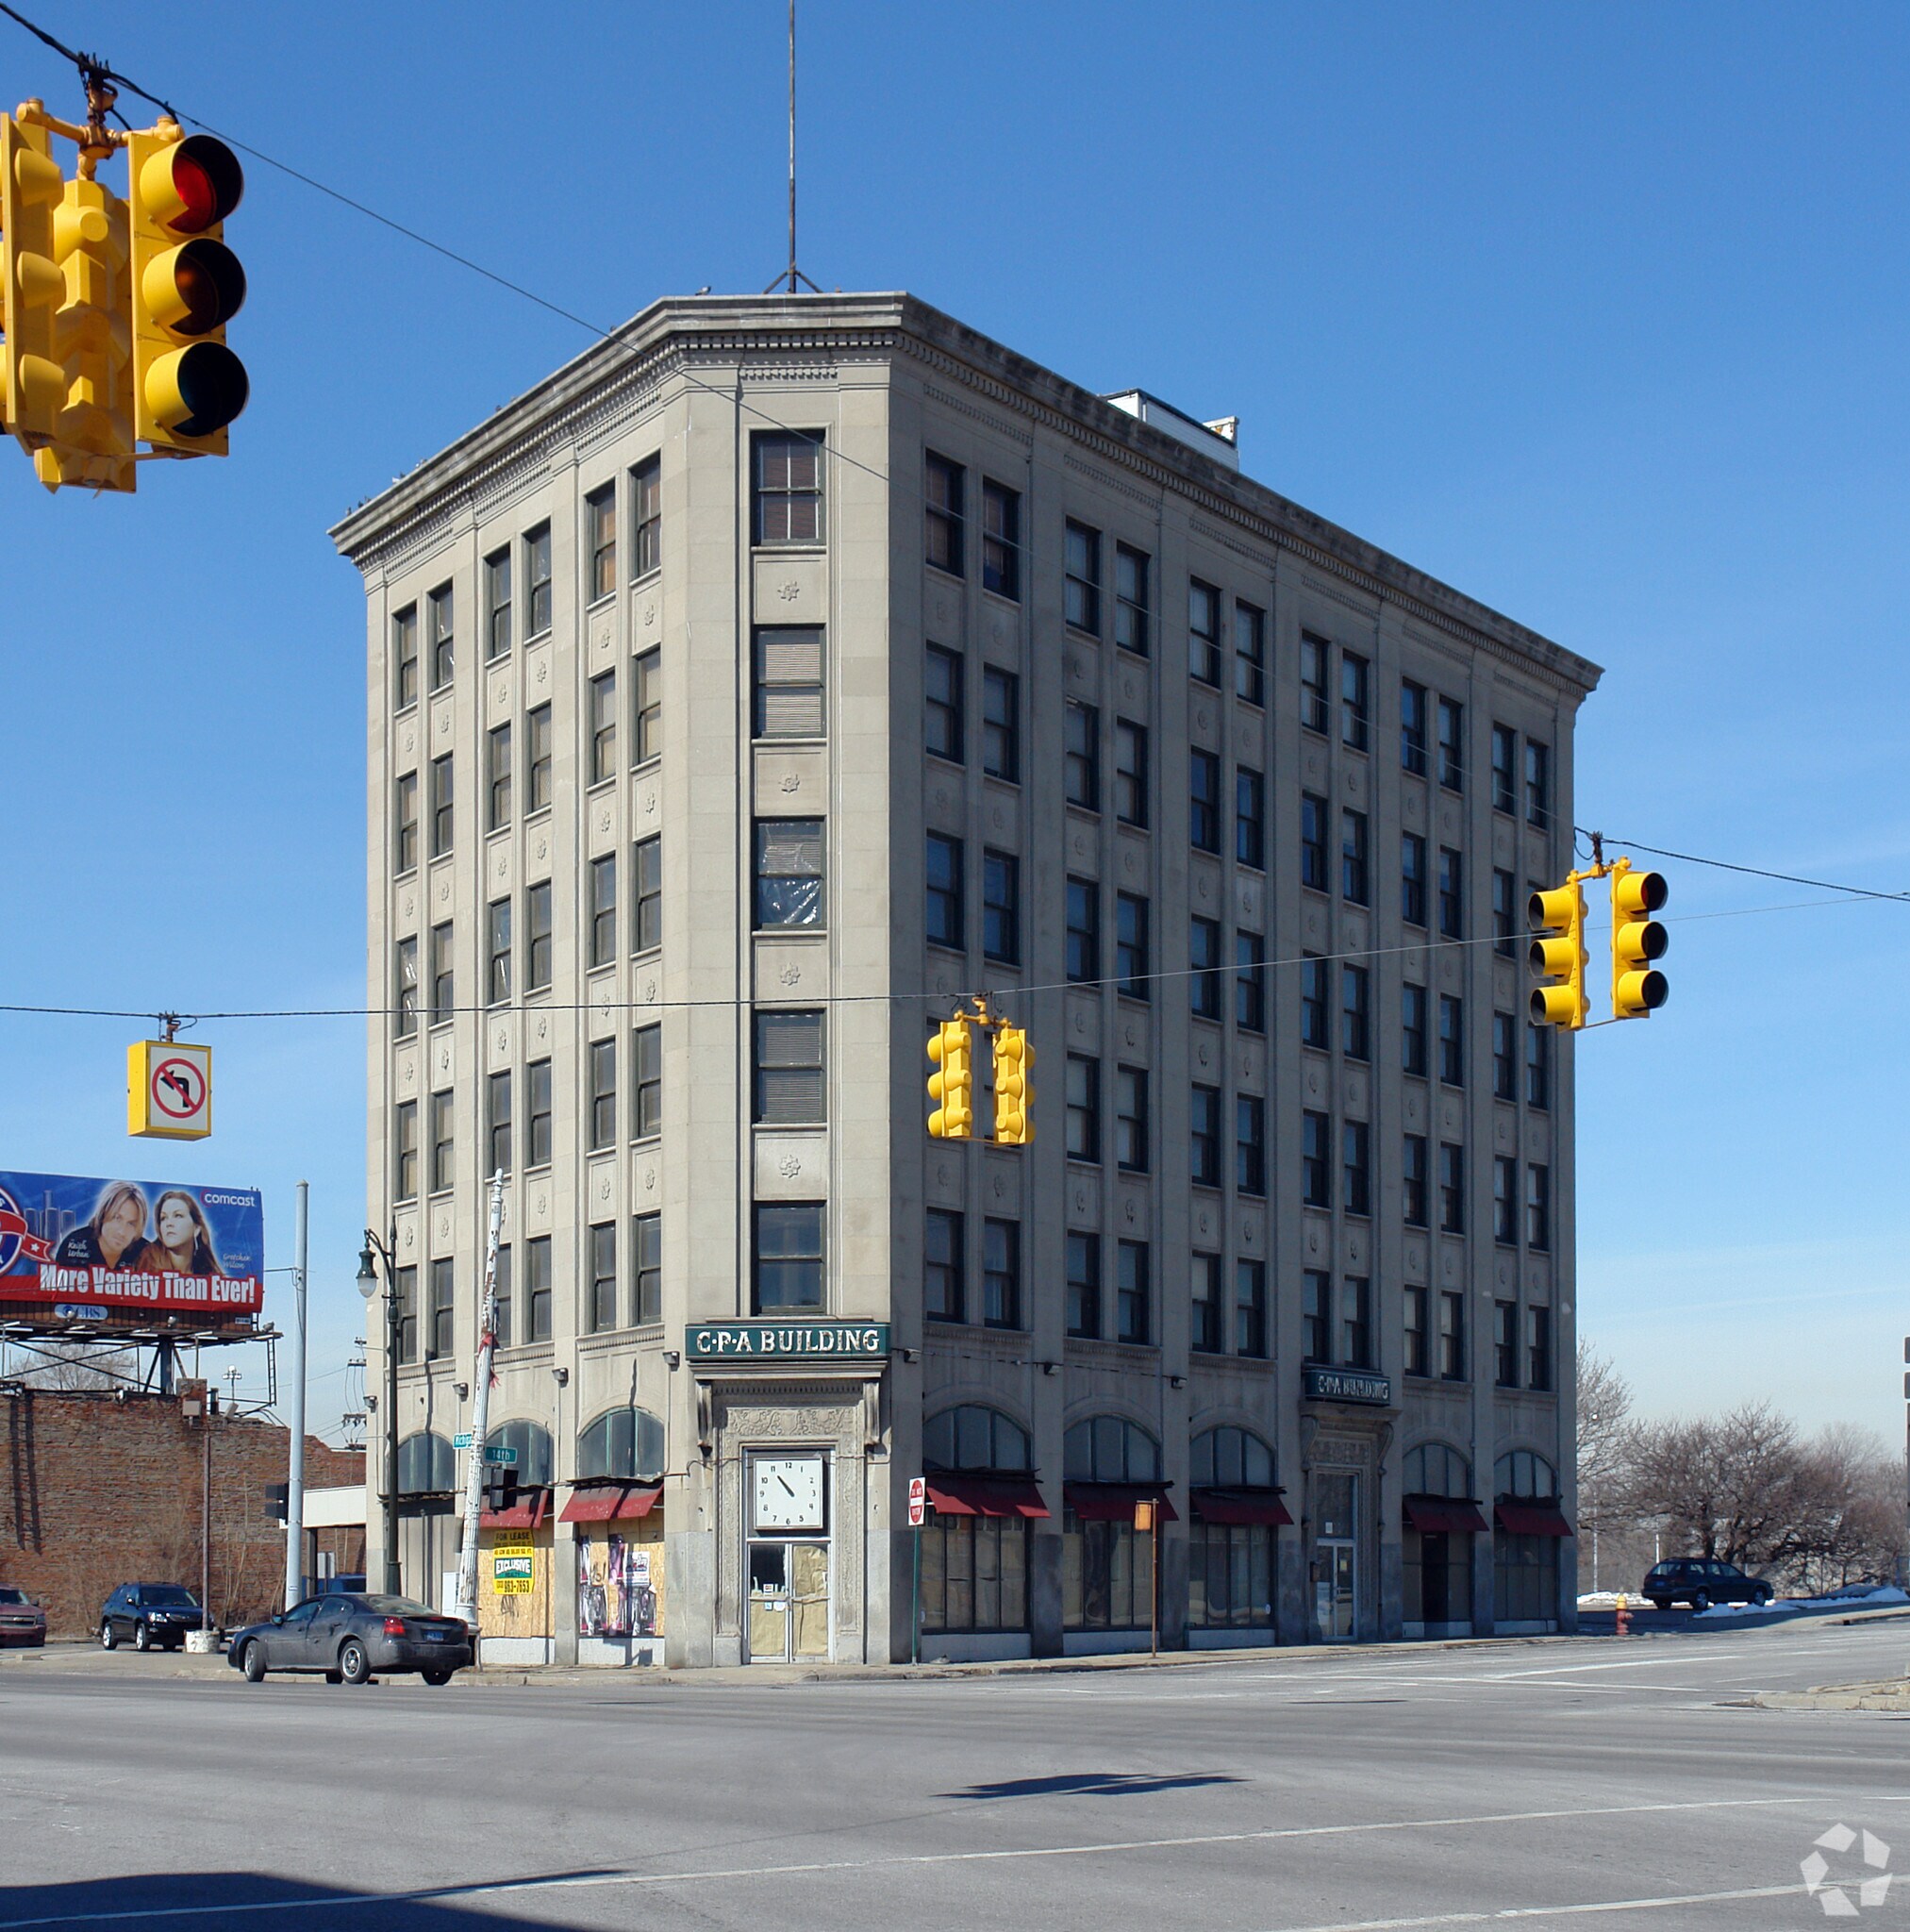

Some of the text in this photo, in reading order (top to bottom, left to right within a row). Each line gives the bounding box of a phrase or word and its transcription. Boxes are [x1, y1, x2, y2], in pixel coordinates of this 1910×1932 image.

[205, 1192, 255, 1207] comcast
[40, 1264, 255, 1303] More Variety Than Ever!
[75, 1306, 101, 1318] CBS
[760, 1330, 879, 1352] BUILDING
[1343, 1378, 1388, 1399] BUILDING
[492, 1449, 510, 1460] 14th
[496, 1532, 507, 1541] FOR
[496, 1559, 530, 1574] EXCLUSIVE
